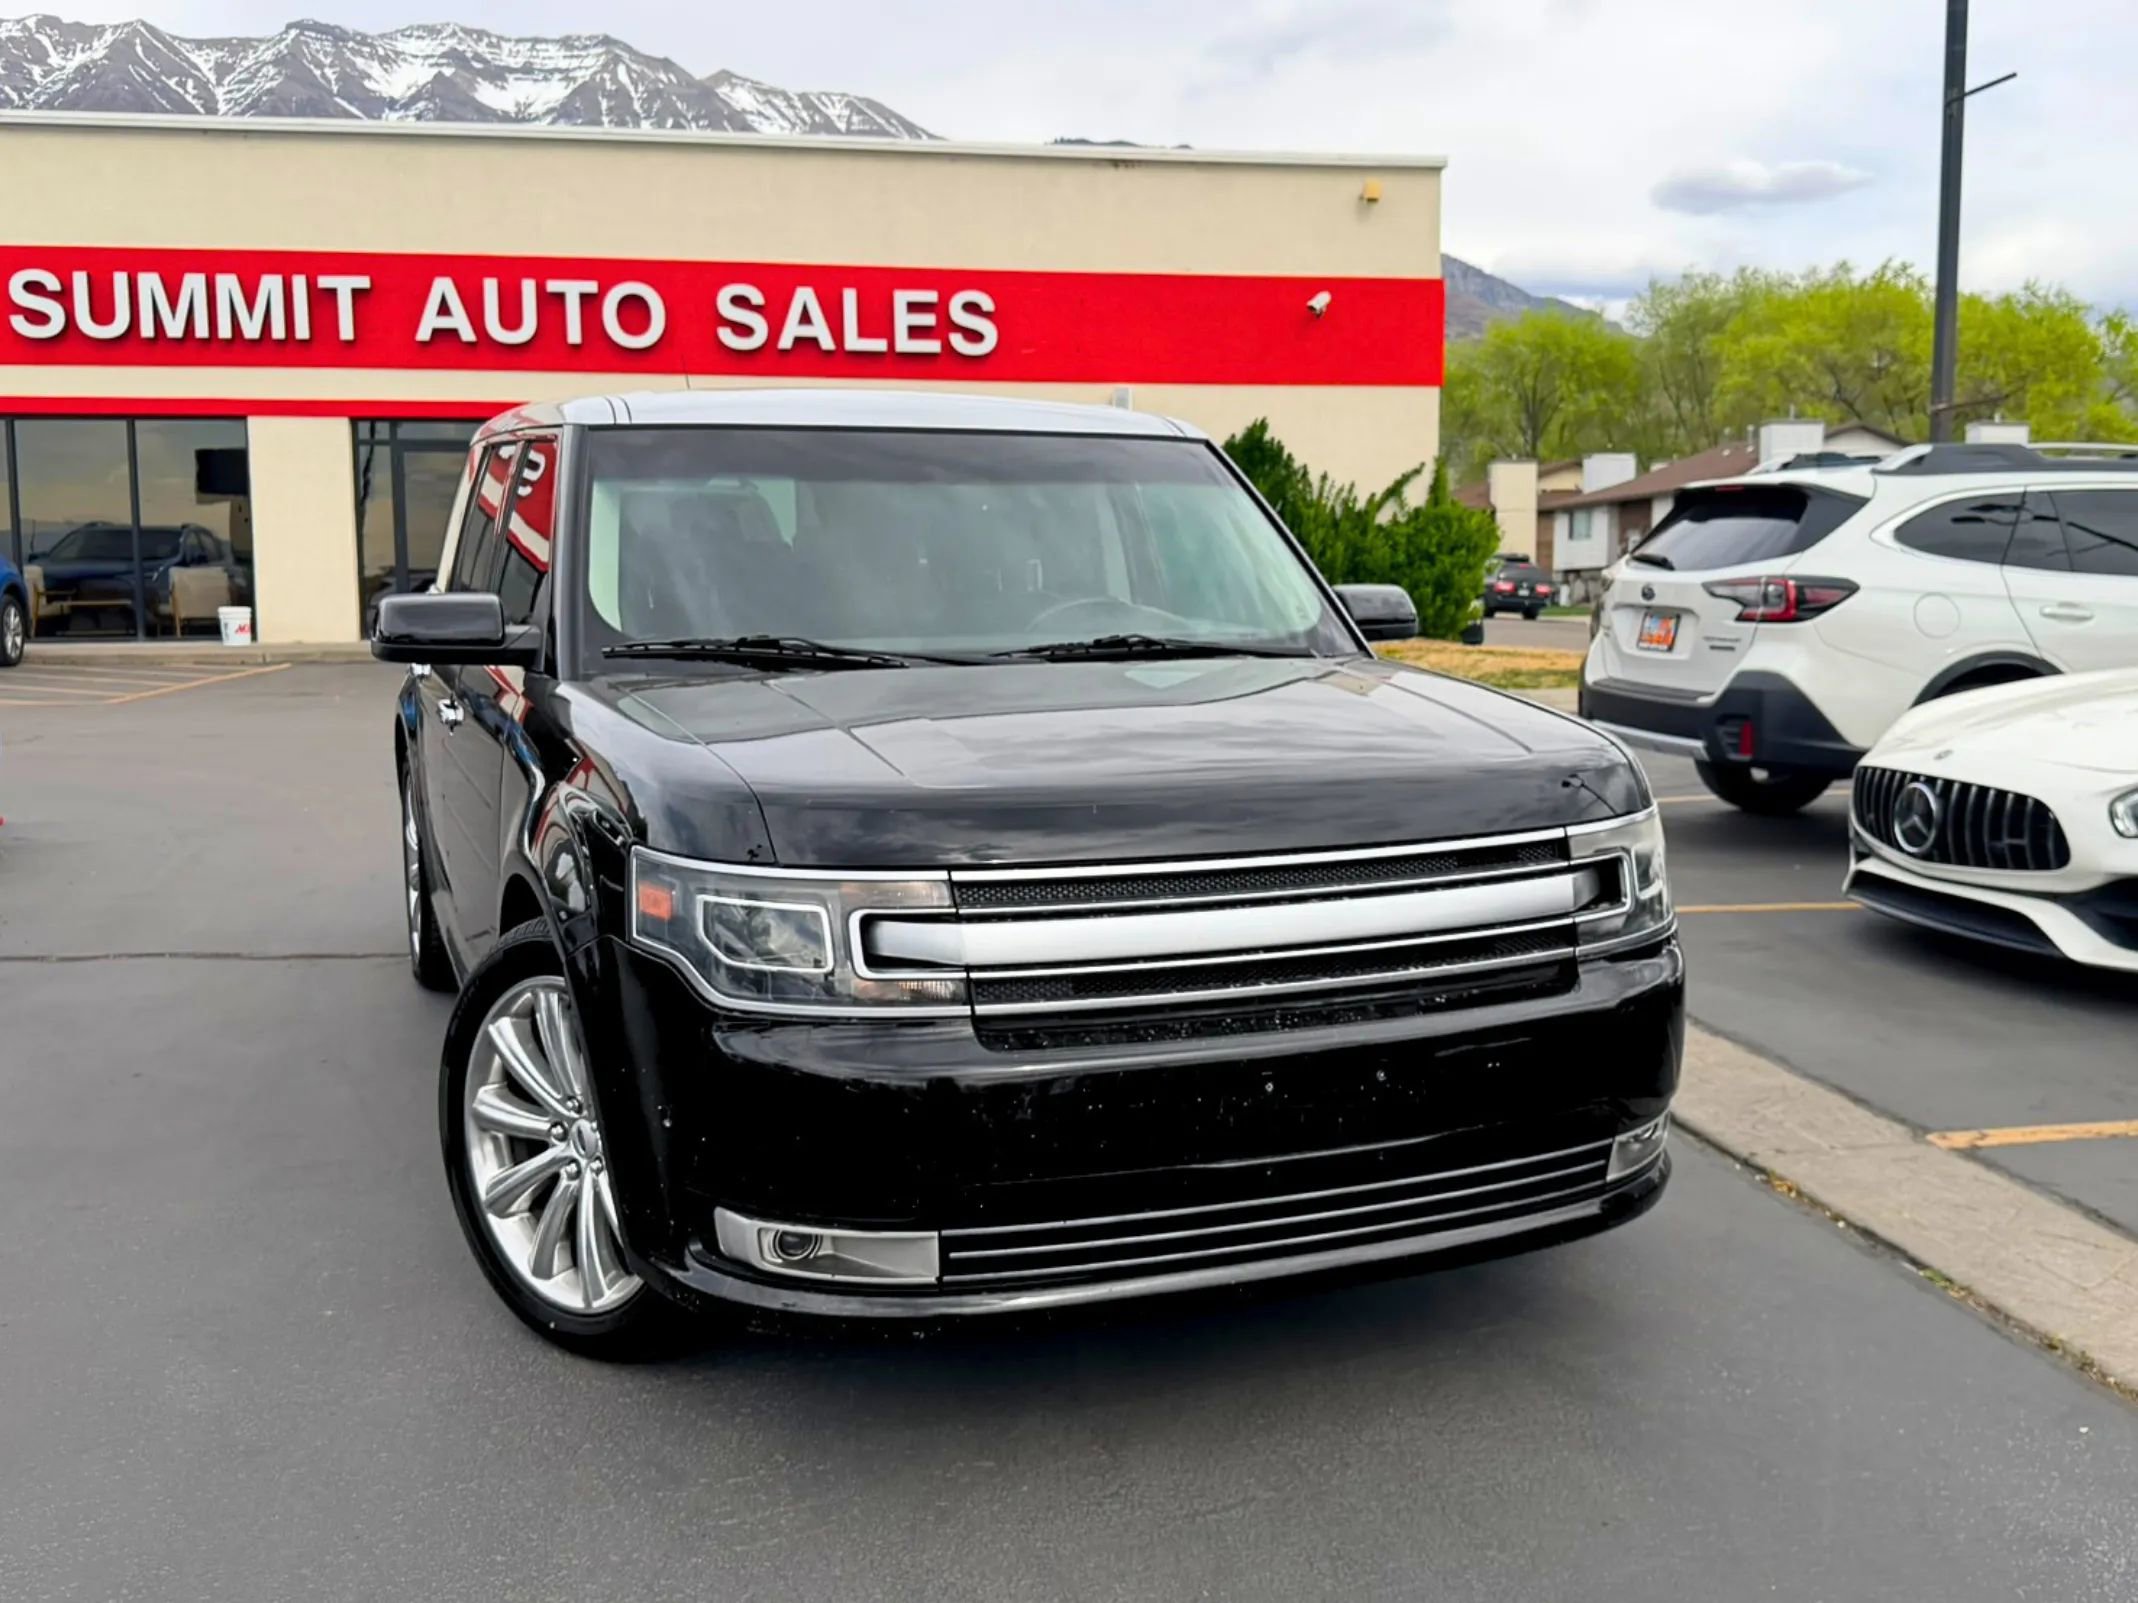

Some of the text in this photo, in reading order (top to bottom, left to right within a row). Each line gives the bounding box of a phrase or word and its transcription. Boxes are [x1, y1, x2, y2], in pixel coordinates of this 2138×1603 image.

[8, 268, 998, 356] SUMMIT AUTO SALES
